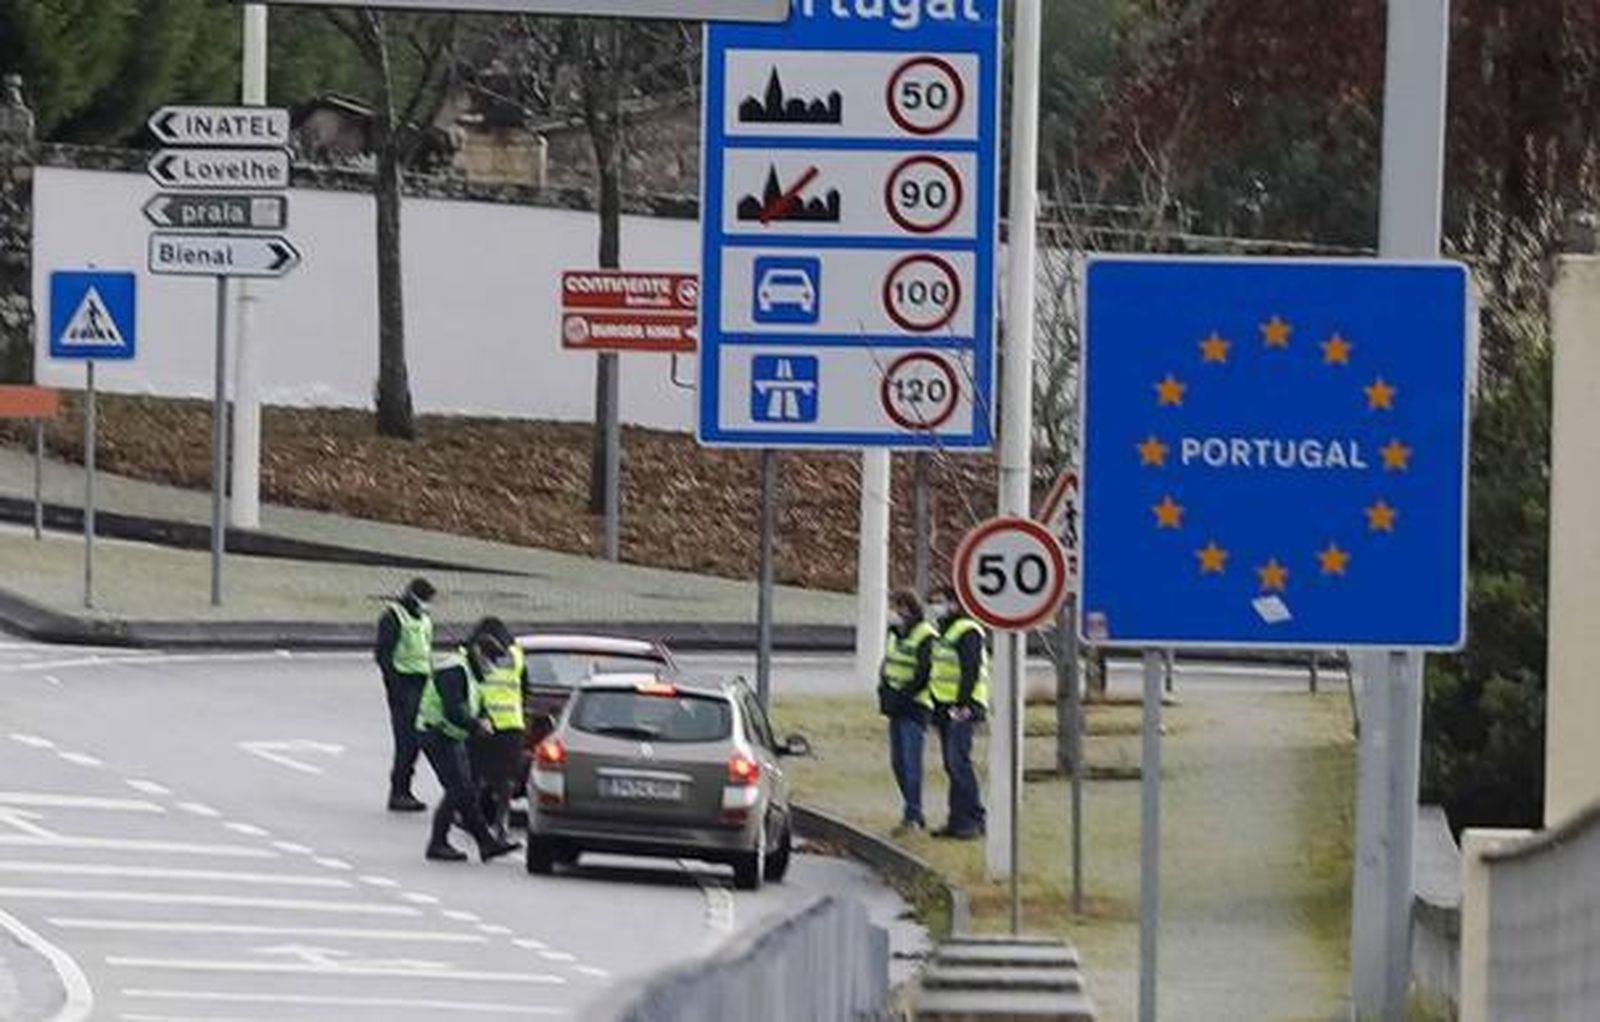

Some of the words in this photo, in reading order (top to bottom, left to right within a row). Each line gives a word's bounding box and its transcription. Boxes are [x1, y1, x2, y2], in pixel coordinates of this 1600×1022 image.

[903, 83, 948, 110] 50
[186, 115, 279, 137] INATEL
[183, 159, 281, 180] Lovelhe
[901, 181, 947, 208] 90
[181, 201, 244, 224] praia
[159, 243, 233, 266] Bienal
[895, 281, 949, 307] 100
[894, 378, 947, 405] 120
[1181, 438, 1367, 469] PORTUGAL
[977, 552, 1048, 596] 50
